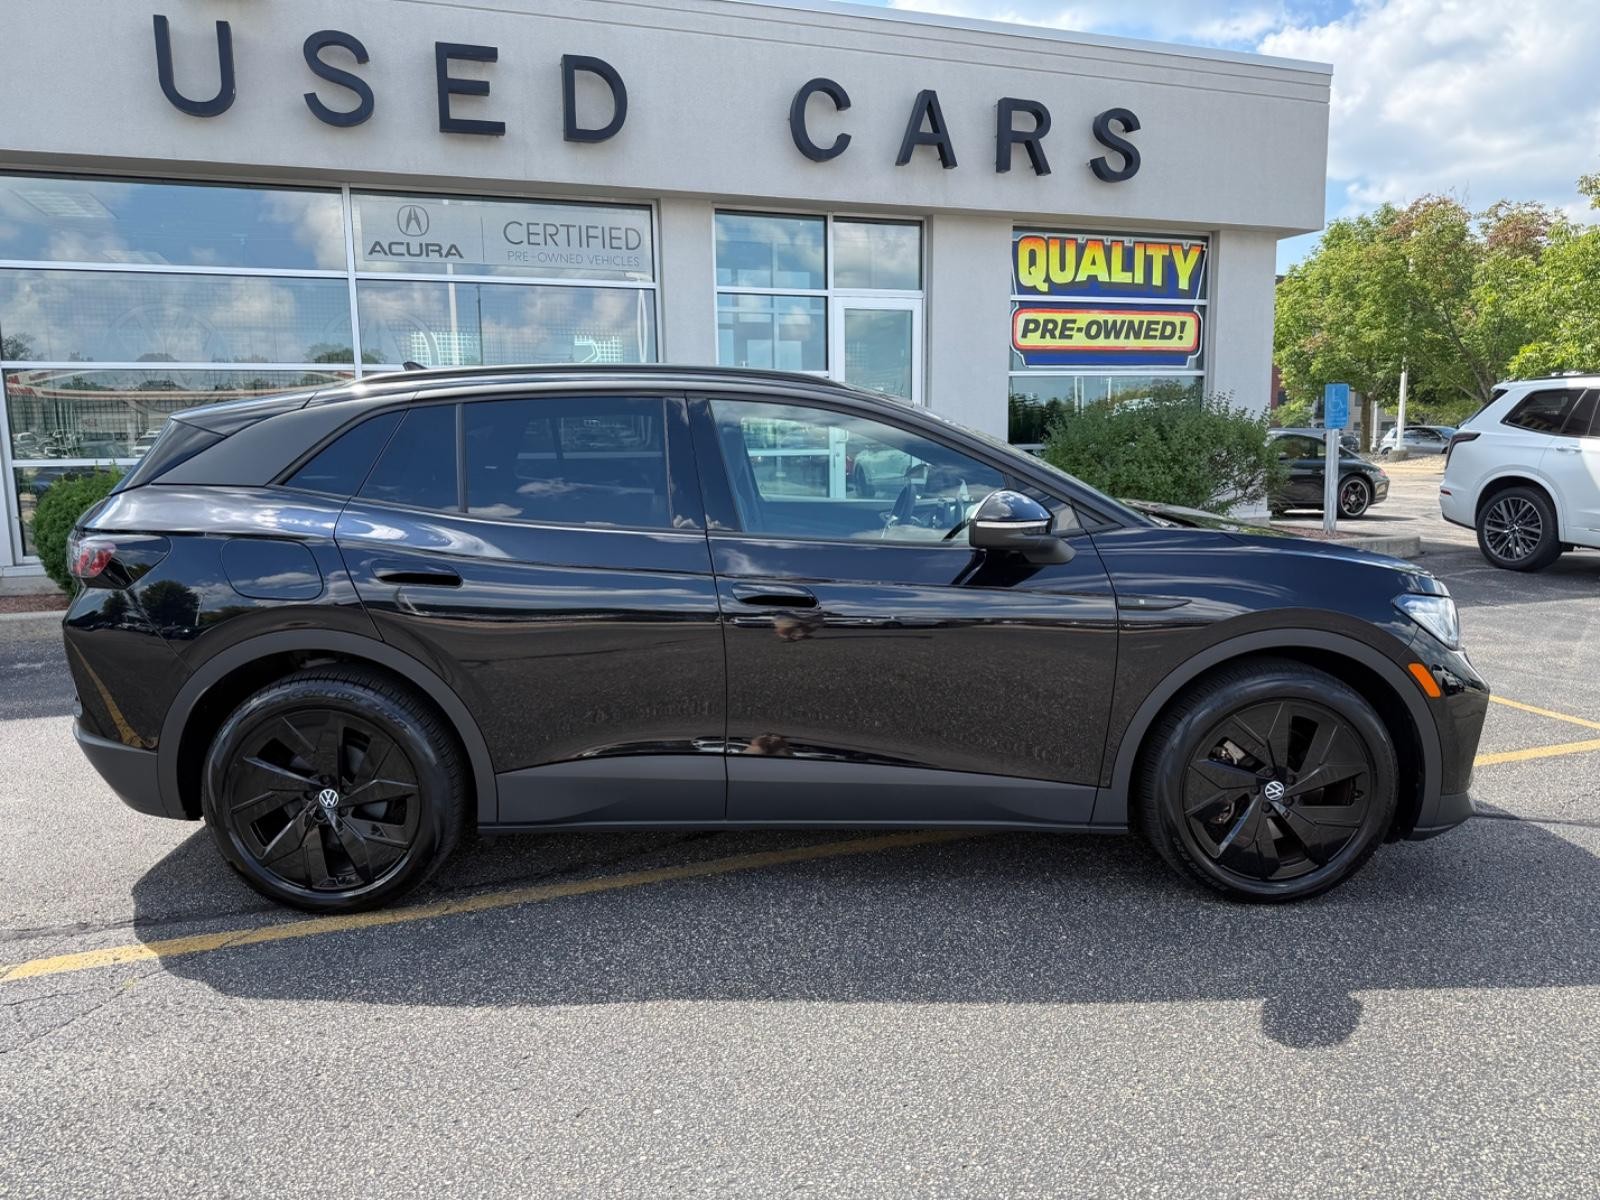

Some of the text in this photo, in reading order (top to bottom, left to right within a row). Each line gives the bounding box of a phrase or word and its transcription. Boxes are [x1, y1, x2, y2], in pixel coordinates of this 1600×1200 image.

[153, 14, 1141, 183] USED CARS
[503, 221, 642, 251] CERTIFIED
[368, 241, 465, 259] ACURA
[586, 254, 640, 267] VEHICLES
[1017, 235, 1201, 292] QUALITY
[1020, 318, 1188, 341] PRE-OWNED!
